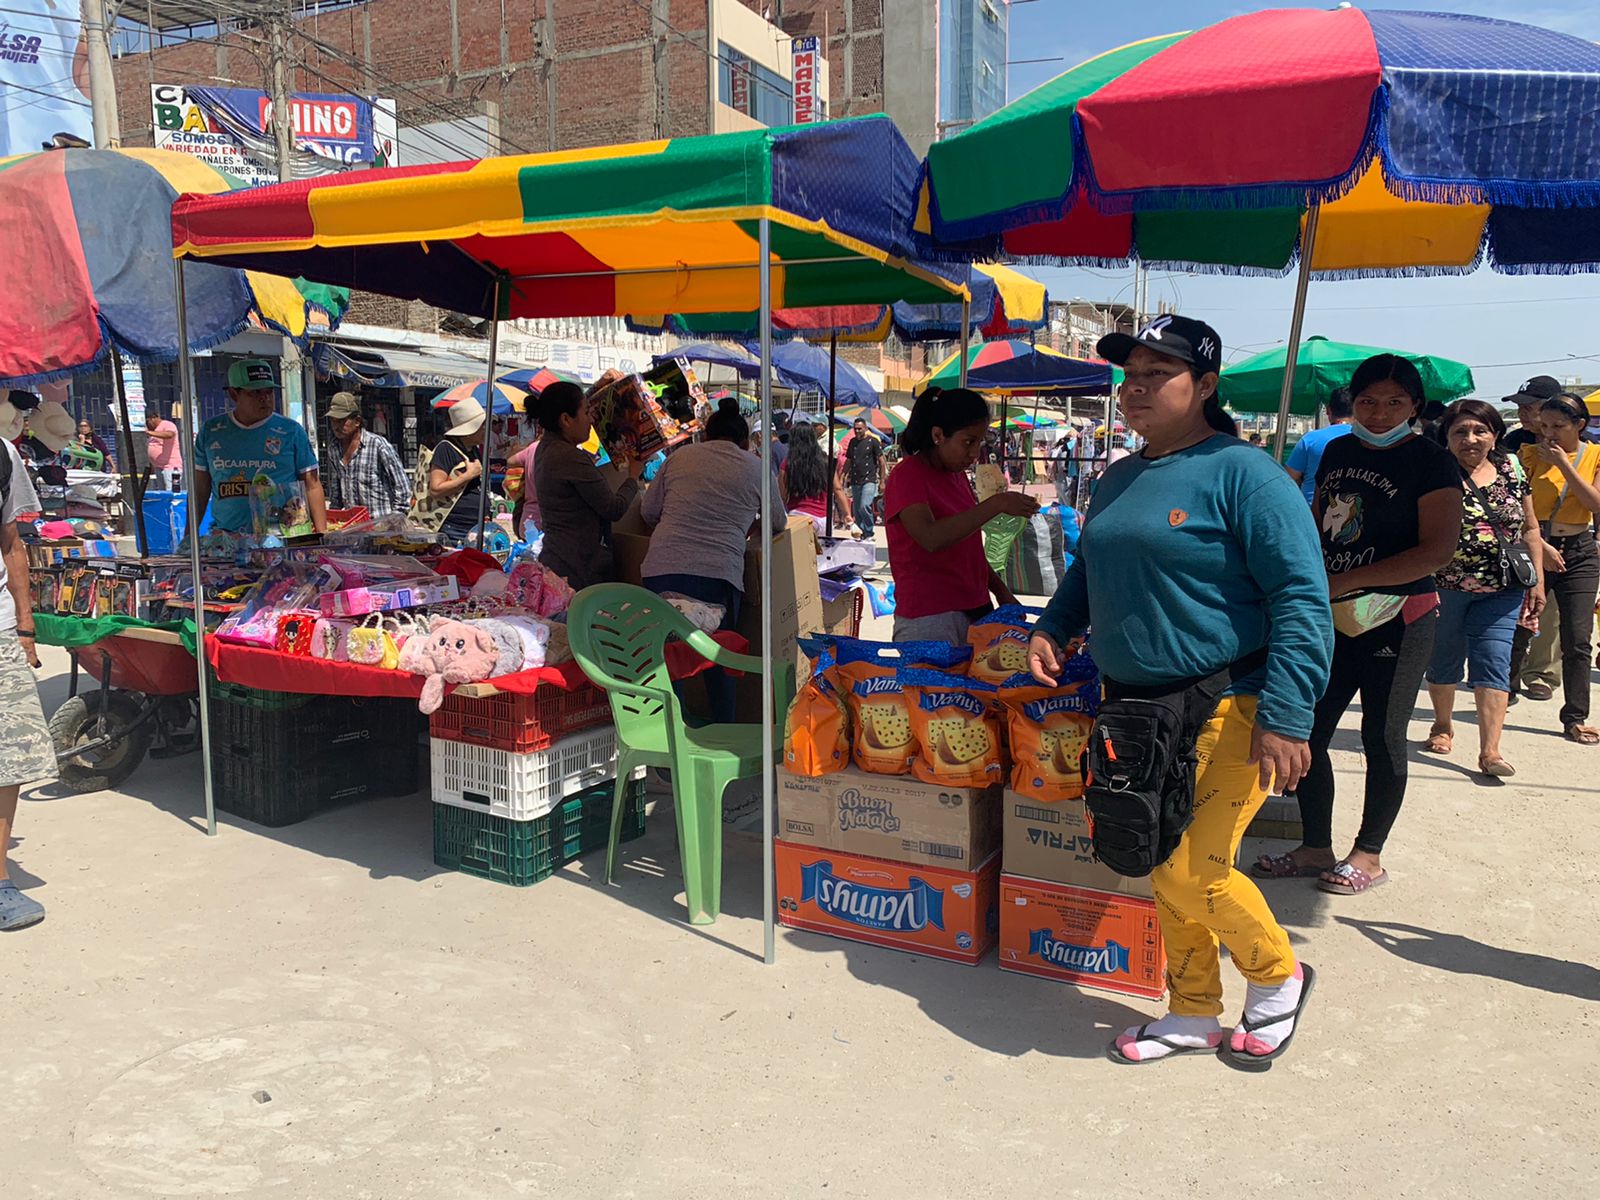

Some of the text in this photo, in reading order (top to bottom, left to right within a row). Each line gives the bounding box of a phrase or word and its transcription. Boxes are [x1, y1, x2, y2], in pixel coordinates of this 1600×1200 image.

[0, 33, 42, 53] LSA
[171, 132, 226, 145] SOMOS
[162, 143, 217, 155] VARIEDAD
[222, 146, 238, 156] EN
[224, 460, 277, 469] CAJA PIURA
[220, 482, 250, 497] CRIST
[928, 691, 982, 715] Vamy's
[787, 822, 813, 834] BOLSA
[1027, 827, 1093, 853] AFRIA
[821, 878, 925, 930] Vamy's
[1043, 940, 1117, 973] Vamy's
